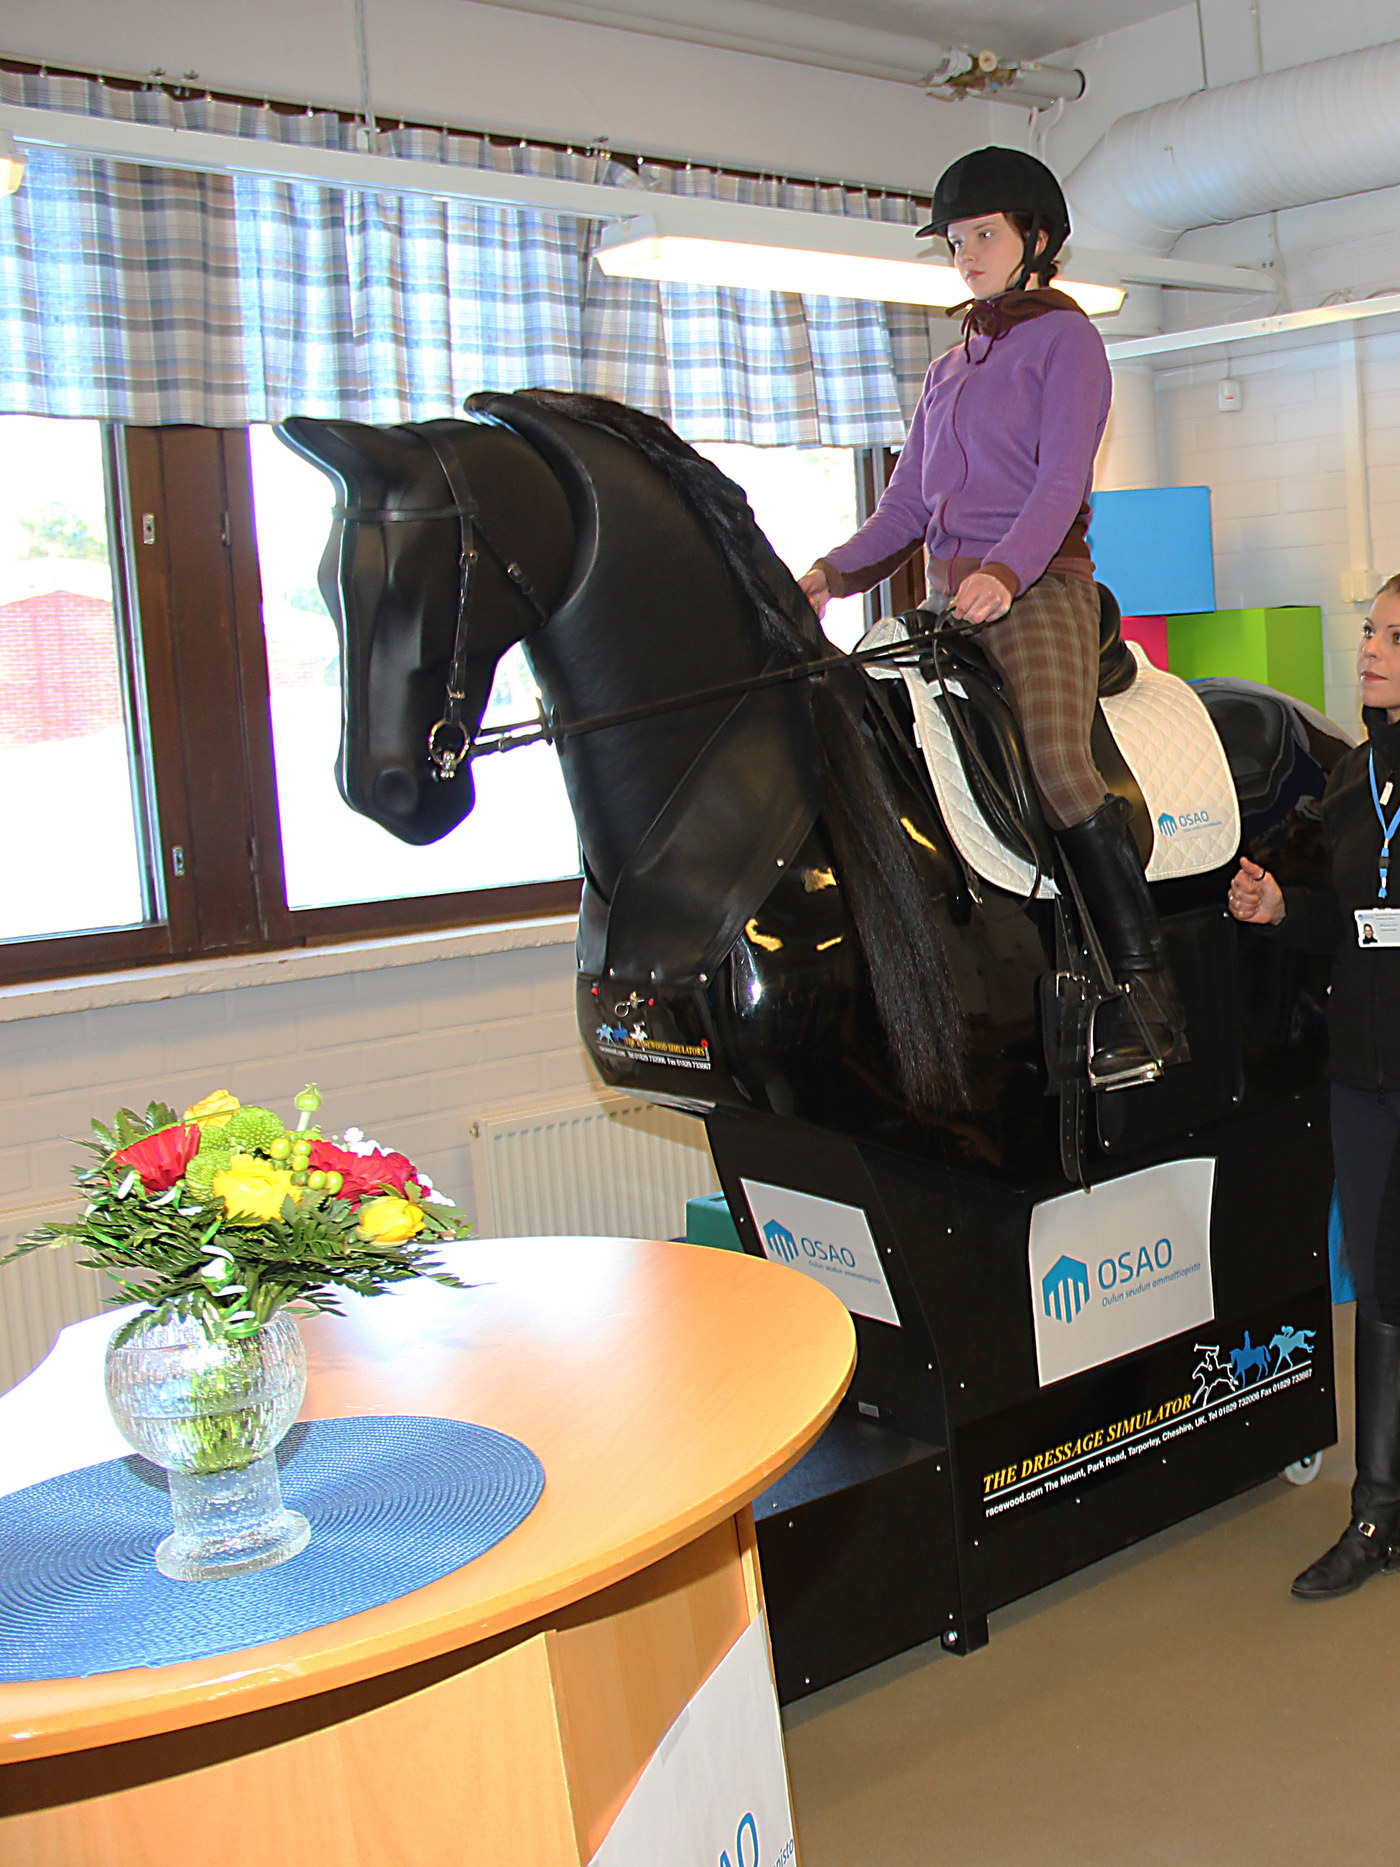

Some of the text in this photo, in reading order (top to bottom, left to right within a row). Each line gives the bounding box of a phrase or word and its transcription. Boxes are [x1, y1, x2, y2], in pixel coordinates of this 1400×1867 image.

[1178, 811, 1209, 827] OSAO
[800, 1237, 856, 1268] OSAO
[1098, 1238, 1173, 1290] OSAO
[1101, 1262, 1201, 1307] Oulun seudun ammattiopisto
[983, 1394, 1192, 1494] THE DRESSAGE SIMULATOR
[985, 1486, 1044, 1518] racewood.com
[1043, 1481, 1060, 1493] The
[1060, 1467, 1087, 1486] Mount,
[1087, 1459, 1105, 1475] Park
[1105, 1450, 1127, 1467] Road,
[1127, 1437, 1162, 1457] Tarporley,
[1162, 1422, 1195, 1442] Cheshire,
[1194, 1415, 1208, 1428] UK.
[1207, 1410, 1218, 1421] Tel
[1218, 1400, 1238, 1417] 01829
[1260, 1387, 1273, 1398] Fax
[1272, 1377, 1291, 1393] 01829
